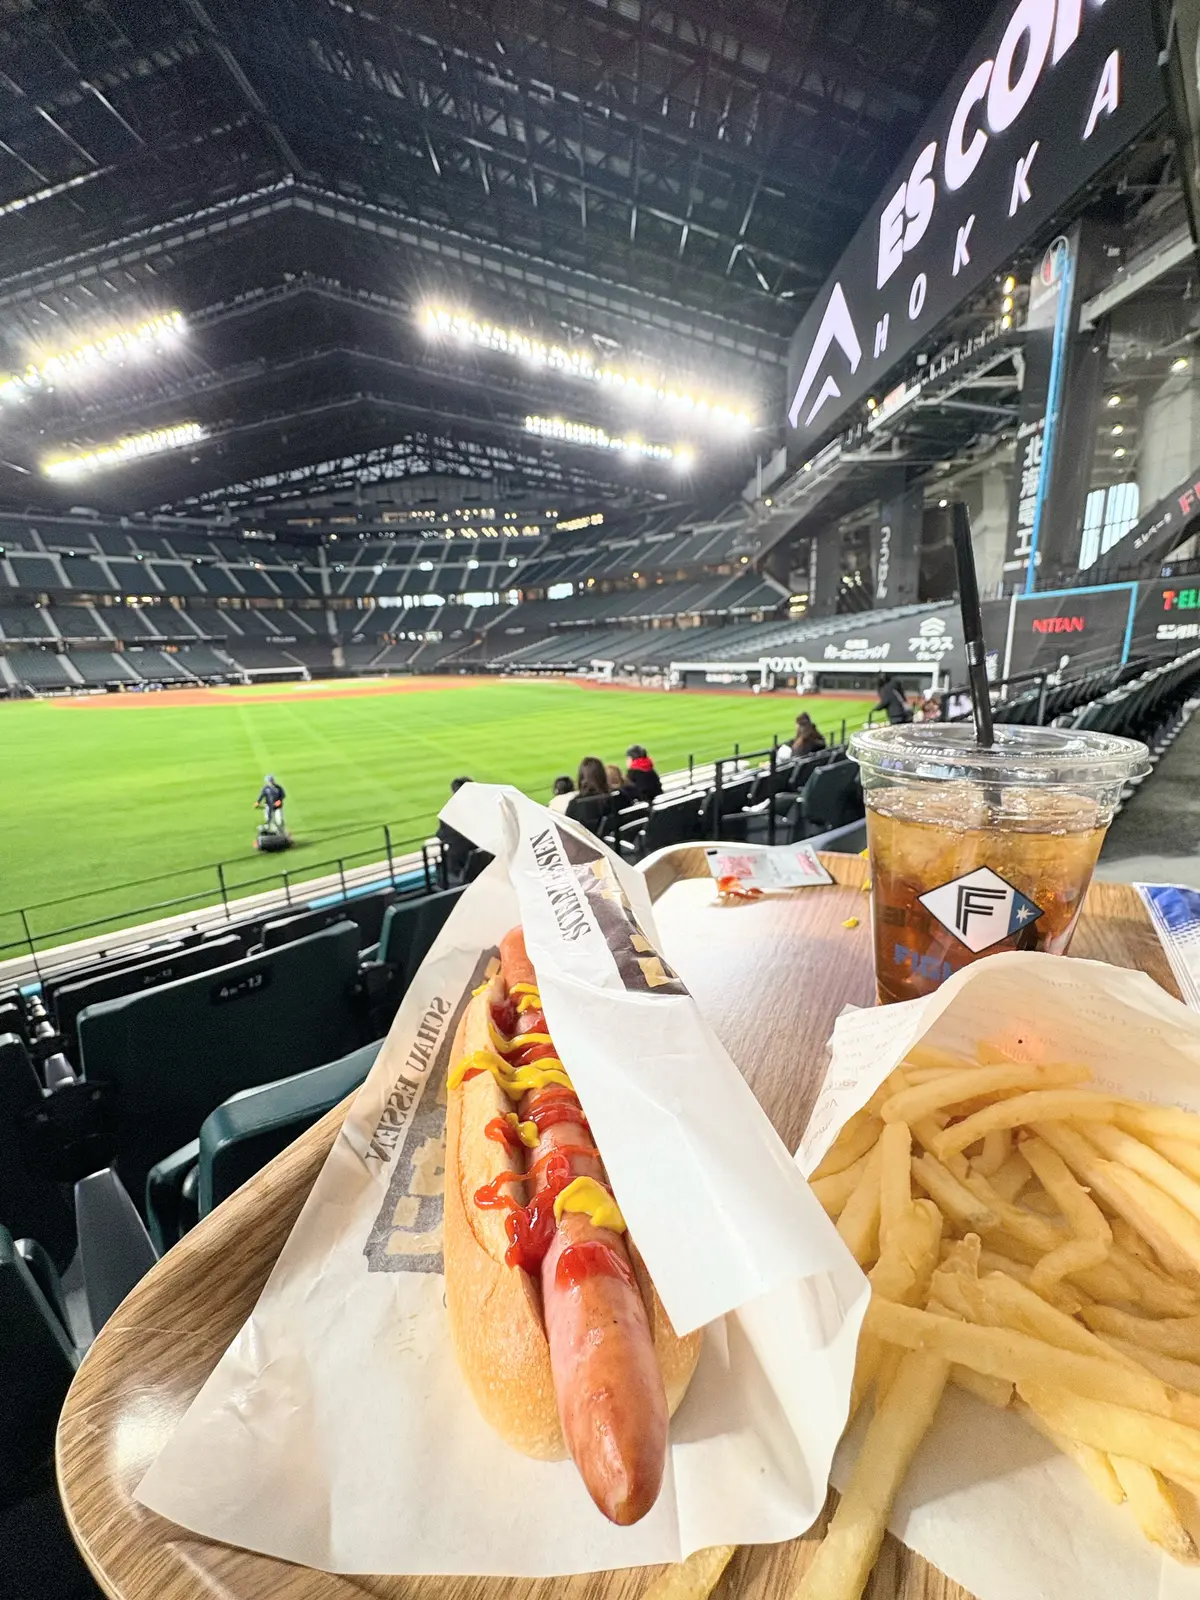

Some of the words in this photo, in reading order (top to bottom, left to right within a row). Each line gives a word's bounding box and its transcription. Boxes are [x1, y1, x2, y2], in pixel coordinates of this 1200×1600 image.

[874, 49, 1120, 358] HOKKA
[758, 656, 808, 673] TOTO
[955, 885, 1007, 936] F
